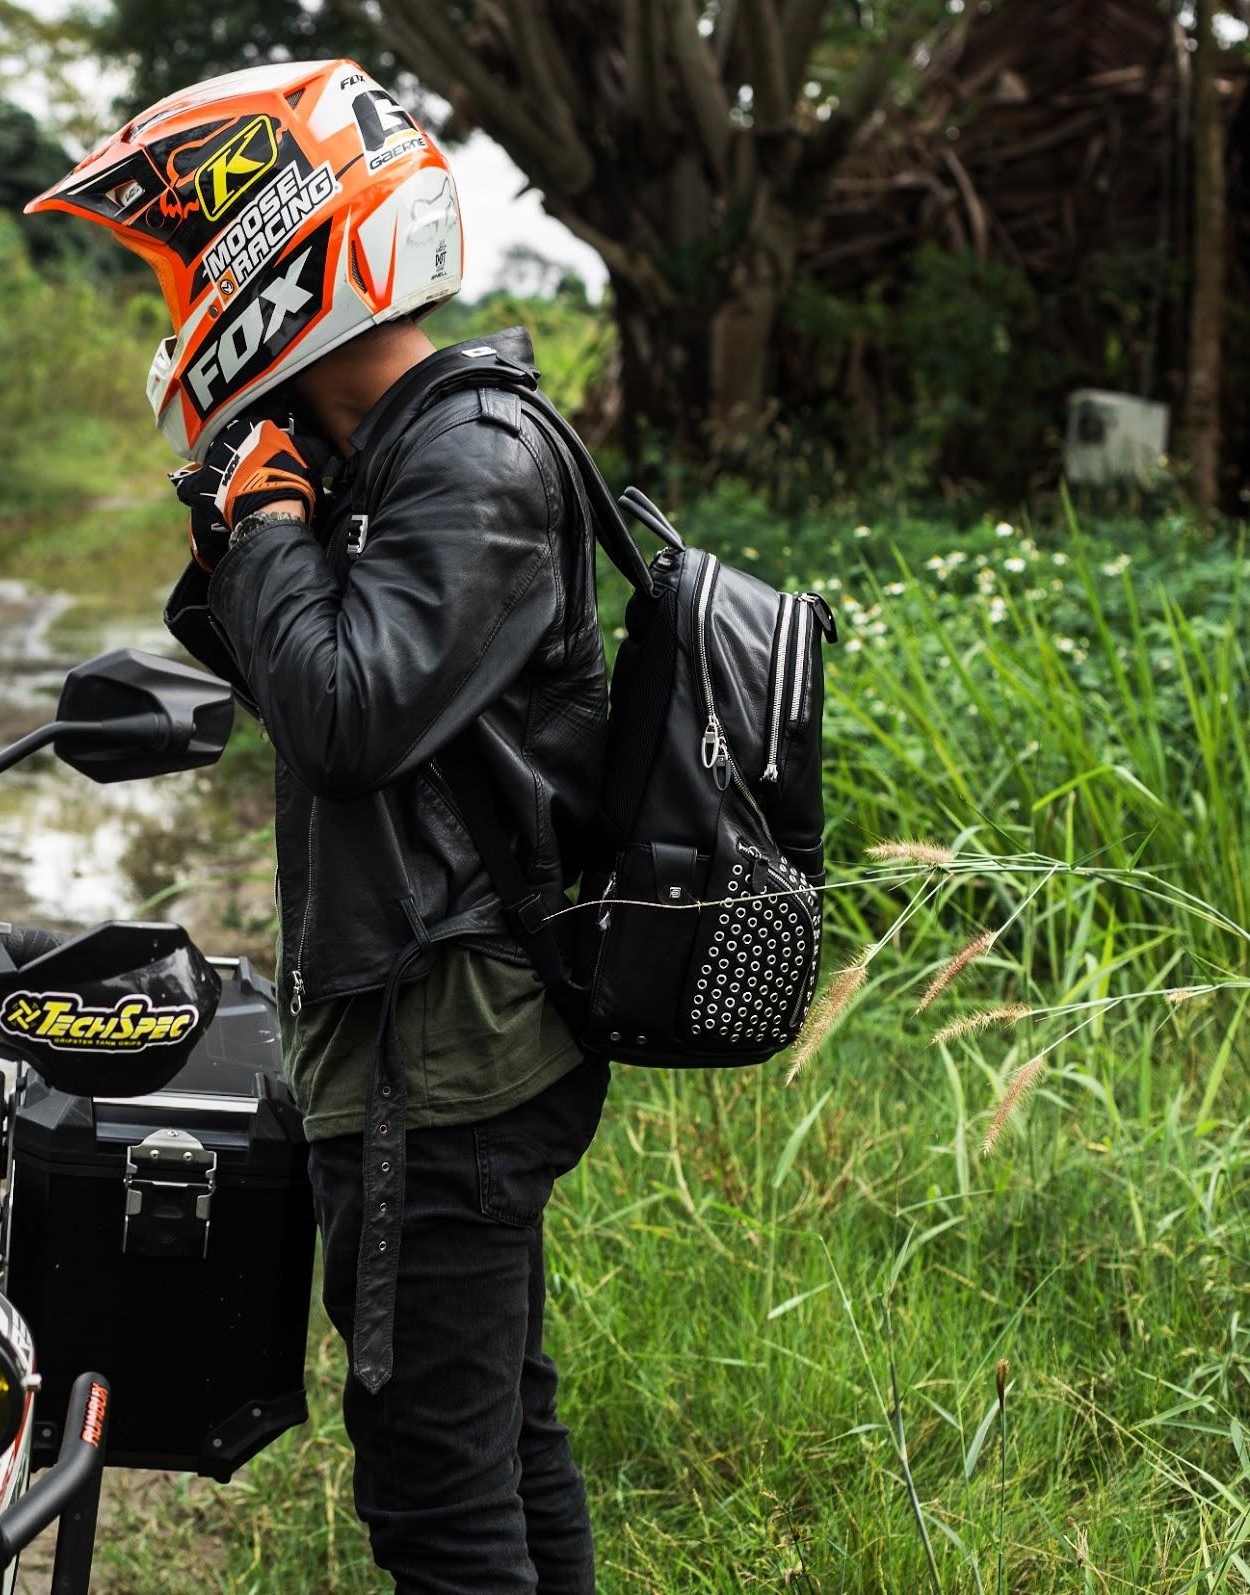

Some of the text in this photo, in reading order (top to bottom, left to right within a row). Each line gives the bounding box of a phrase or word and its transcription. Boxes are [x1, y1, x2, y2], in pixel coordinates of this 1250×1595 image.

[206, 168, 300, 278] MOOSE
[207, 123, 265, 214] K
[232, 167, 333, 285] RACING
[187, 246, 314, 411] FOX
